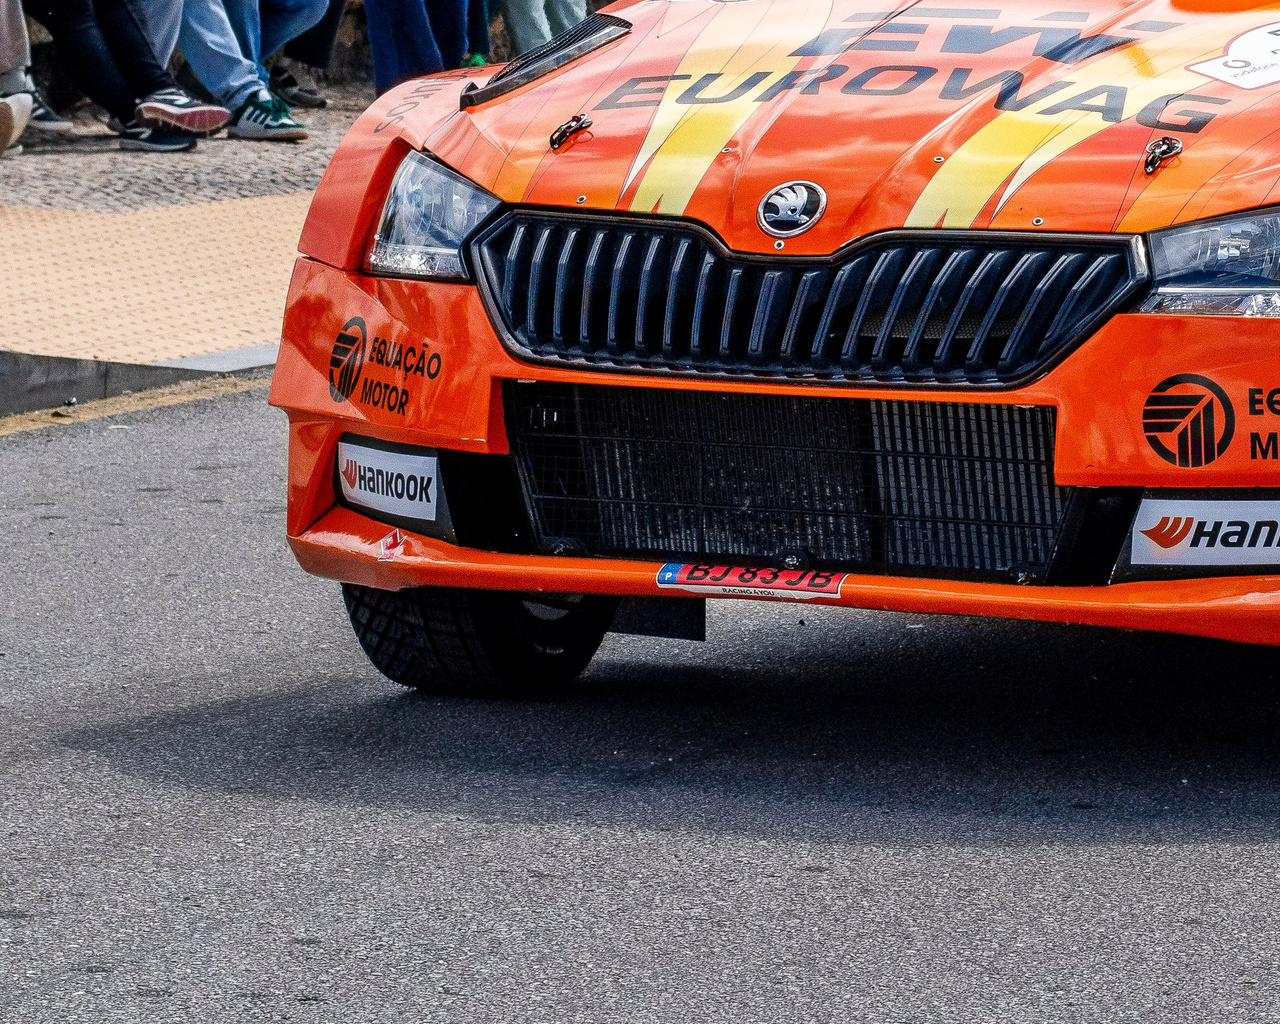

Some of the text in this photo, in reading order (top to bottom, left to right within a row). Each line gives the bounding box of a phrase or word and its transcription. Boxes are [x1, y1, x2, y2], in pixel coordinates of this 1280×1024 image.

[590, 63, 1234, 135] EUROWAG
[368, 336, 442, 381] EQUAÇÃO
[359, 377, 410, 416] MOTOR
[664, 572, 674, 582] P
